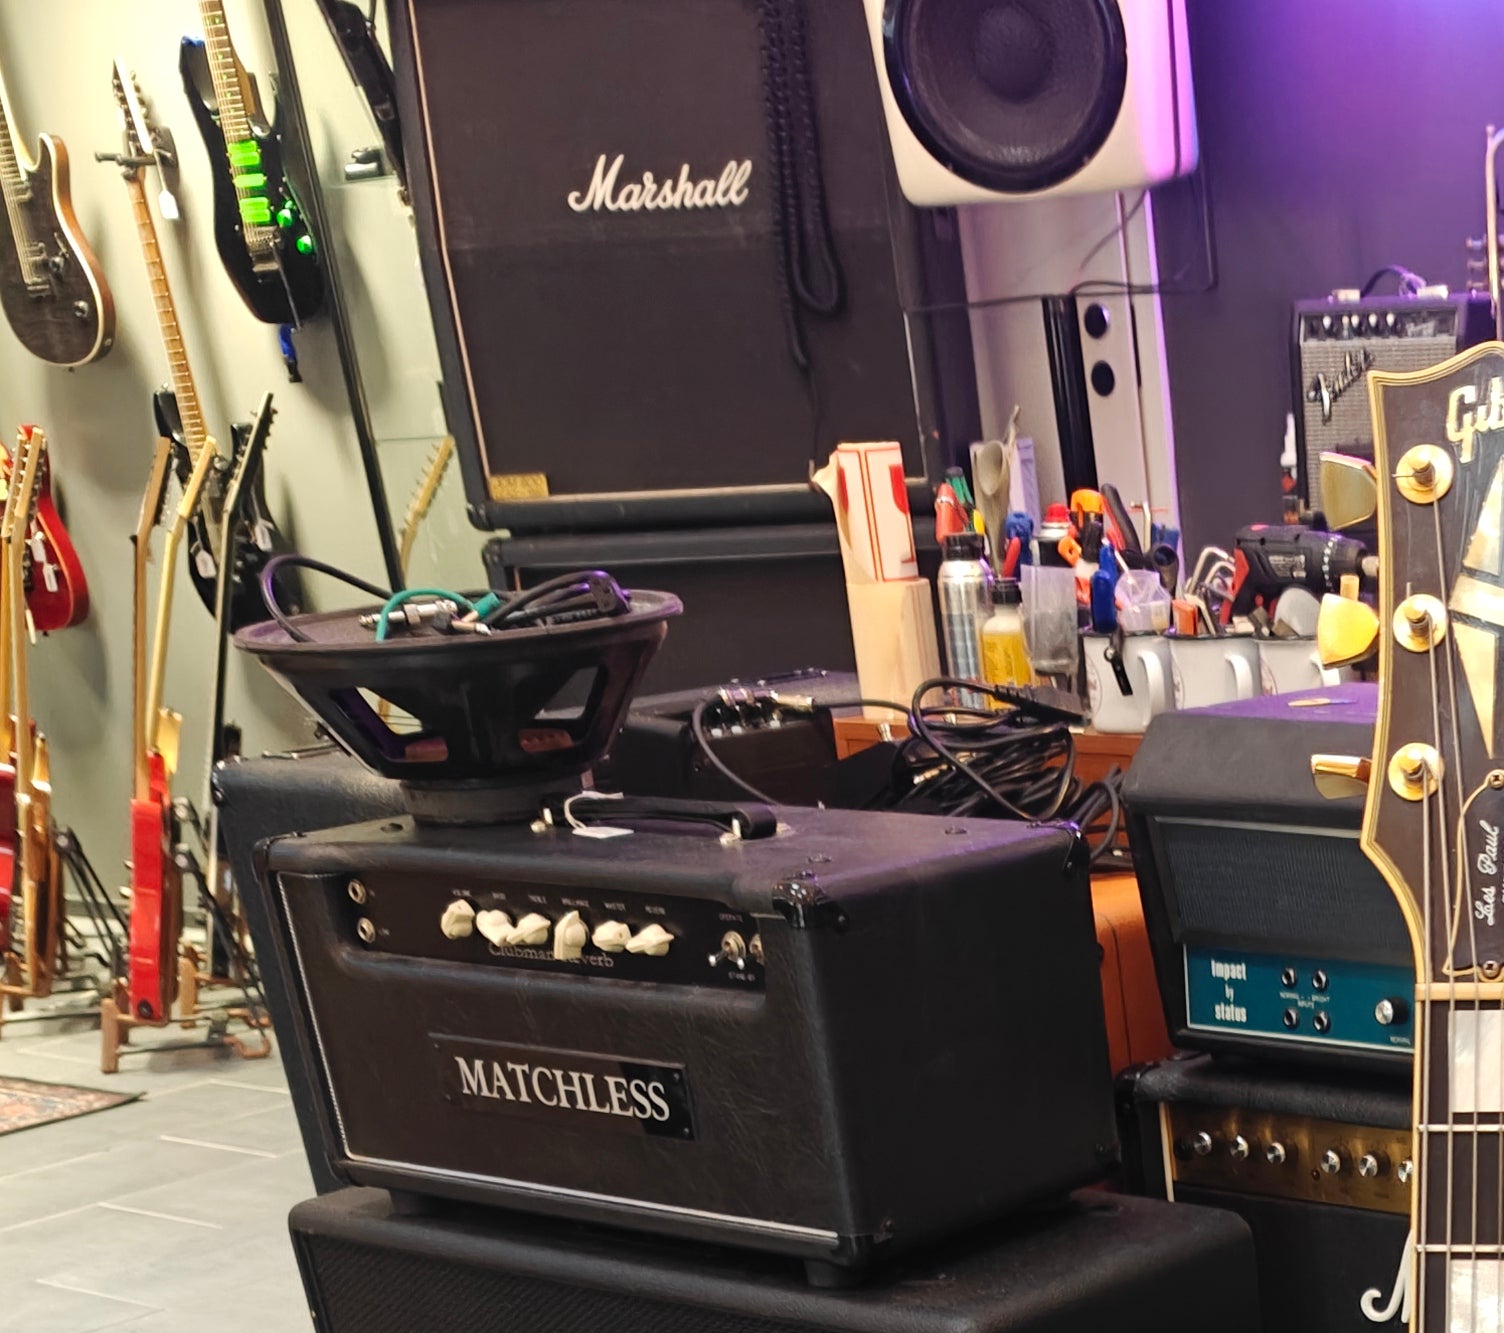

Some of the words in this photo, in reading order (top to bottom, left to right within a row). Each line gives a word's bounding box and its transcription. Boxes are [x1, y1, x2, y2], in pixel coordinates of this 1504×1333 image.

[567, 154, 753, 212] Marshall
[1477, 820, 1499, 875] Paul
[1475, 886, 1495, 926] Les
[1211, 959, 1247, 981] Impact
[1215, 1003, 1247, 1023] status
[454, 1057, 670, 1121] MATCHLESS
